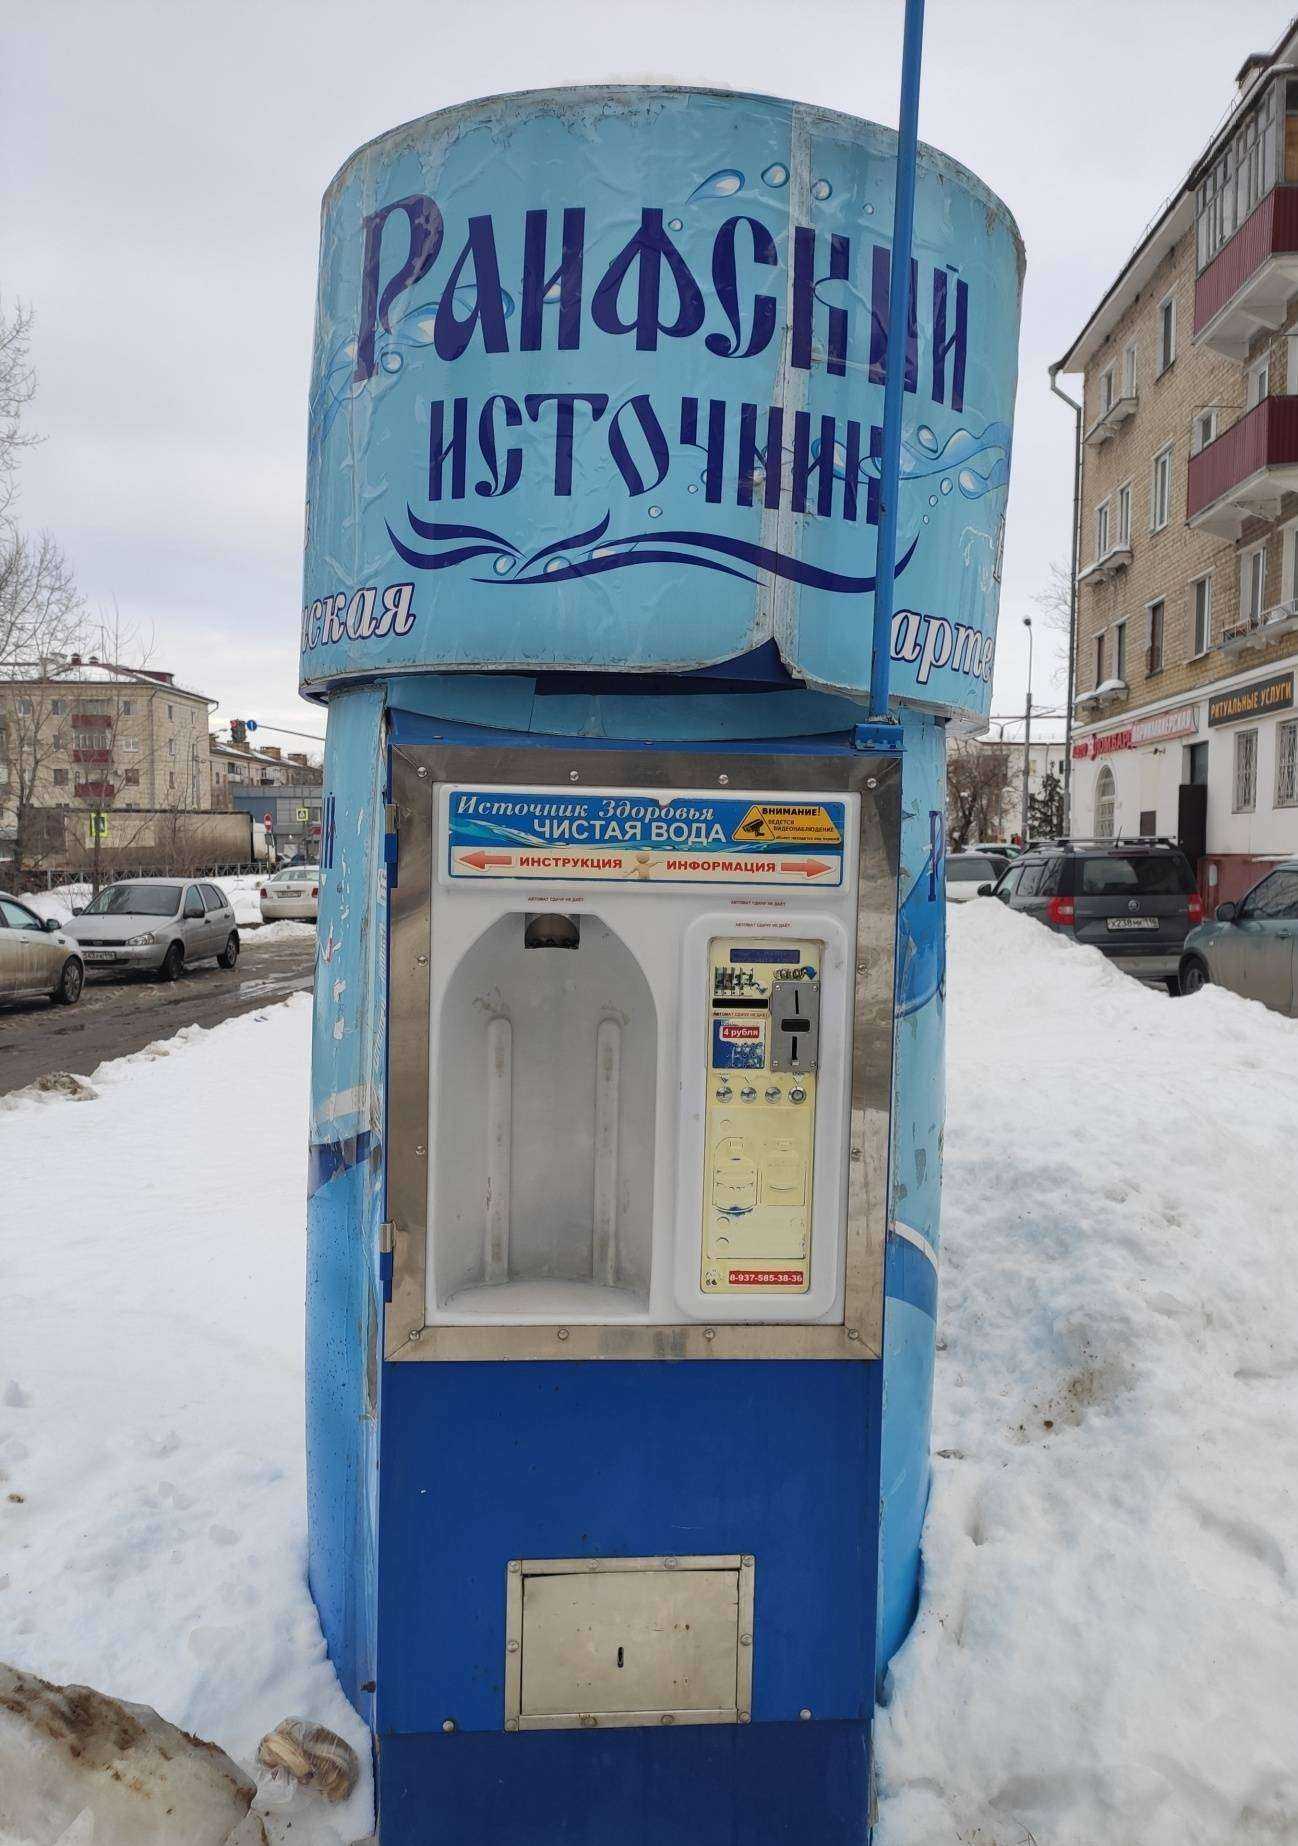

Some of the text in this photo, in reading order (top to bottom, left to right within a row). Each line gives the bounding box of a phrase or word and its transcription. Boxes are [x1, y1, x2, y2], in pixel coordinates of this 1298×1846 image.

[1210, 681, 1292, 720] РИТУАЛЬНЫЕ УСЛУГИ
[457, 796, 715, 823] Источник Здоровья
[762, 807, 821, 816] ВНИМАНИЕ!
[533, 819, 727, 846] ЧИСТАЯ ВОДА
[519, 856, 623, 869] ИНСТРУКЦИЯ
[666, 860, 776, 874] ИНФОРМАЦИЯ
[731, 1028, 759, 1037] рубля
